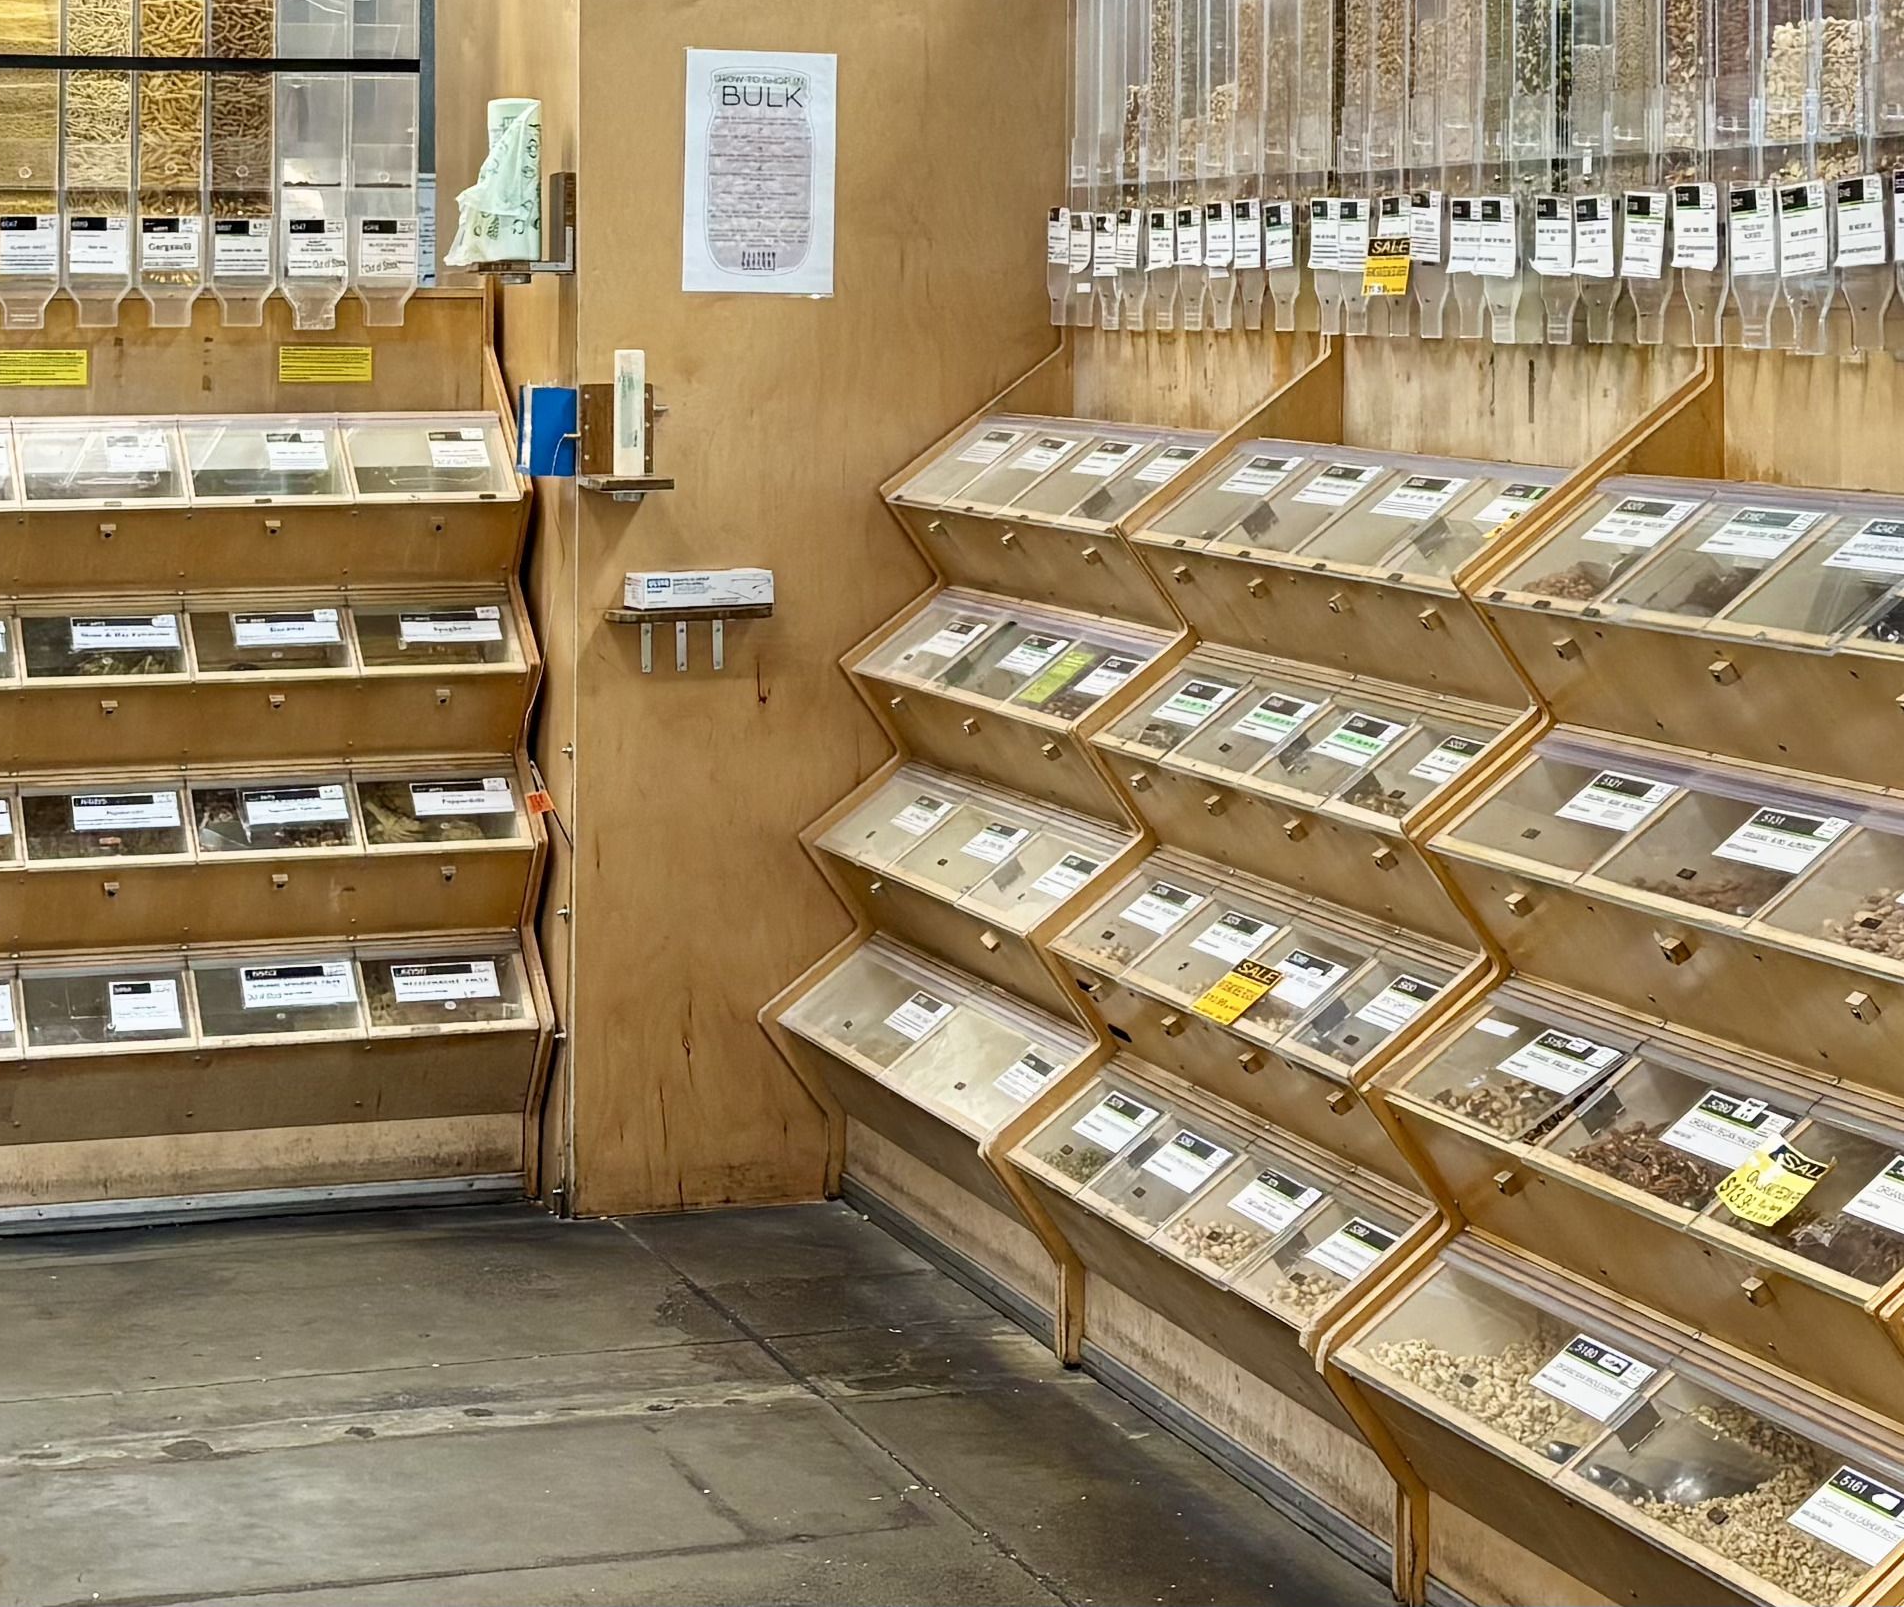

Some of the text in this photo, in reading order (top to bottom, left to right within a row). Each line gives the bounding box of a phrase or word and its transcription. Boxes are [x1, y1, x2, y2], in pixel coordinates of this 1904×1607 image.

[722, 85, 804, 108] BULK
[1371, 240, 1410, 254] SALE
[1238, 961, 1278, 984] SALE
